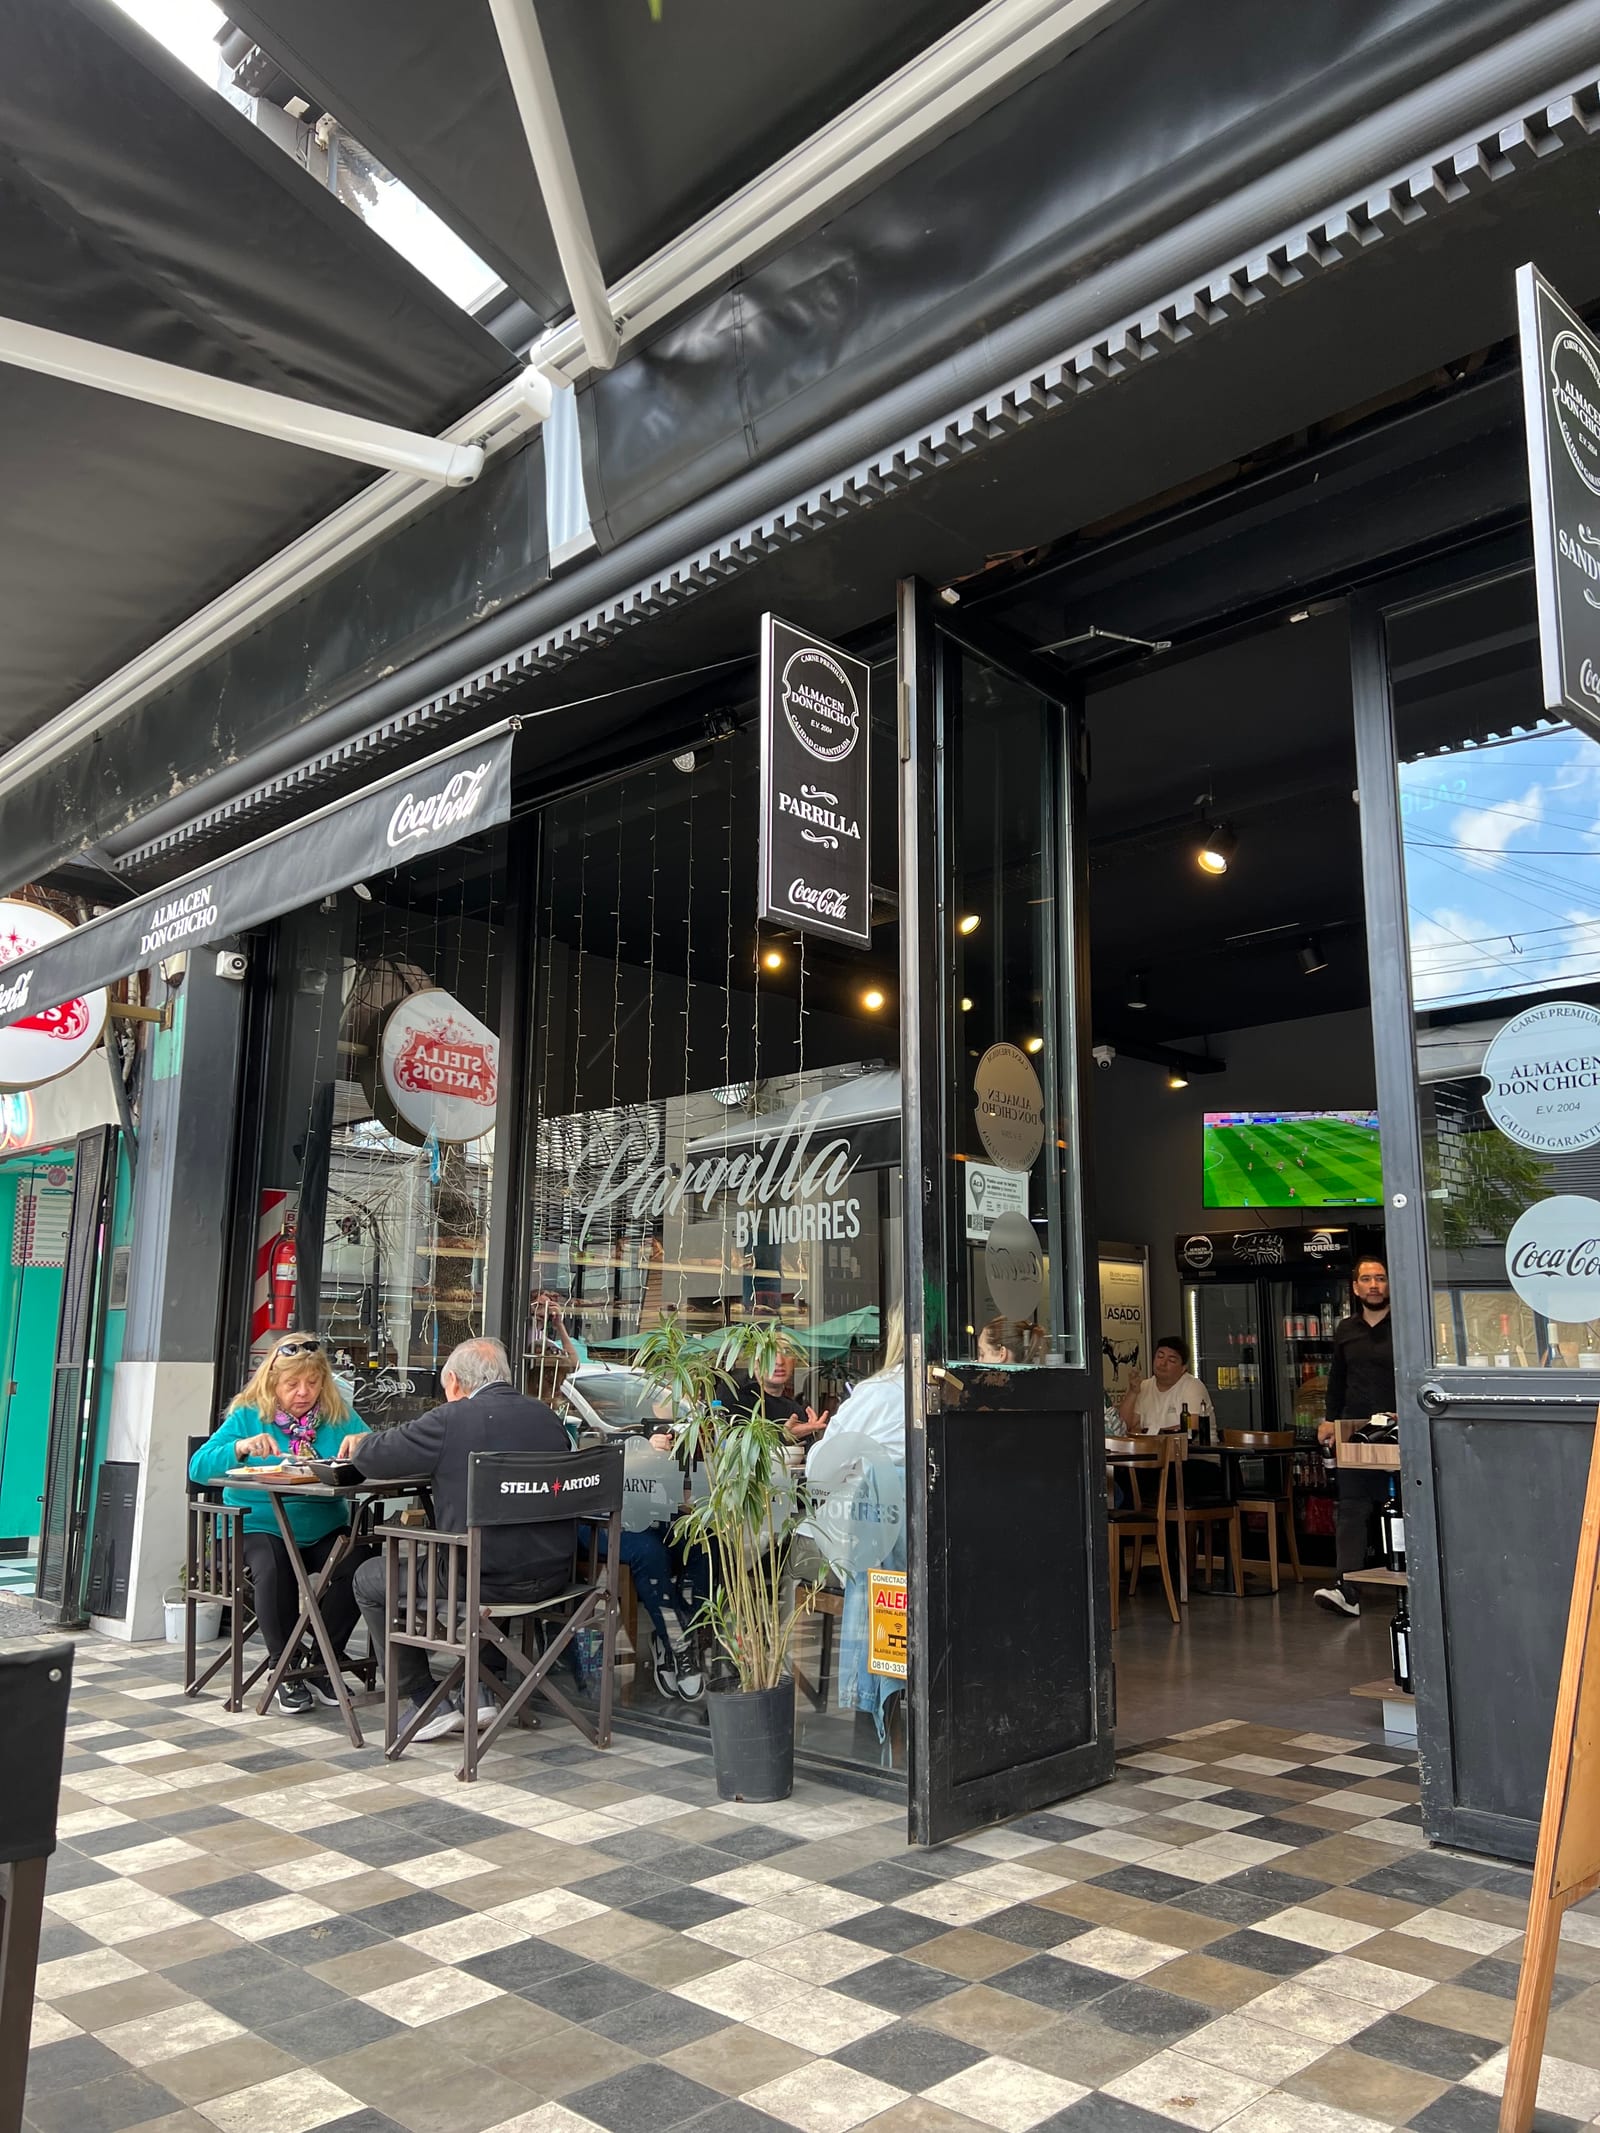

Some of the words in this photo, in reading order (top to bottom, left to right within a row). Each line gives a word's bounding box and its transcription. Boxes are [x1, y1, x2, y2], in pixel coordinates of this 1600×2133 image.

[1560, 388, 1580, 418] DON
[800, 654, 819, 663] CARNE
[819, 656, 844, 684] PREMIUM
[791, 691, 813, 710] DON
[813, 701, 850, 726] CHICHO
[798, 684, 844, 712] ALMACEN
[791, 714, 814, 748] CALIDAD
[813, 738, 850, 755] GARANTIZADA
[387, 759, 492, 847] Coca-Cola
[779, 792, 860, 839] PARRILLA
[150, 885, 212, 930] ALMACEN
[788, 878, 849, 919] Coca-Cola
[1511, 1010, 1547, 1034] CARNE
[1510, 1056, 1600, 1080] ALMACEN
[1498, 1080, 1539, 1097] DON
[1557, 1102, 1581, 1113] 2004
[1500, 1114, 1545, 1146] CALIDAD
[1547, 1121, 1600, 1147] GARANTI
[736, 1208, 763, 1249] BY
[768, 1198, 861, 1246] MORRES
[1304, 1243, 1341, 1253] MORRES
[1511, 1238, 1600, 1279] Coca-Co
[1107, 1307, 1140, 1321] ASADO
[500, 1481, 550, 1495] STELLA
[562, 1474, 600, 1492] ARTOIS
[623, 1477, 656, 1494] ARNE
